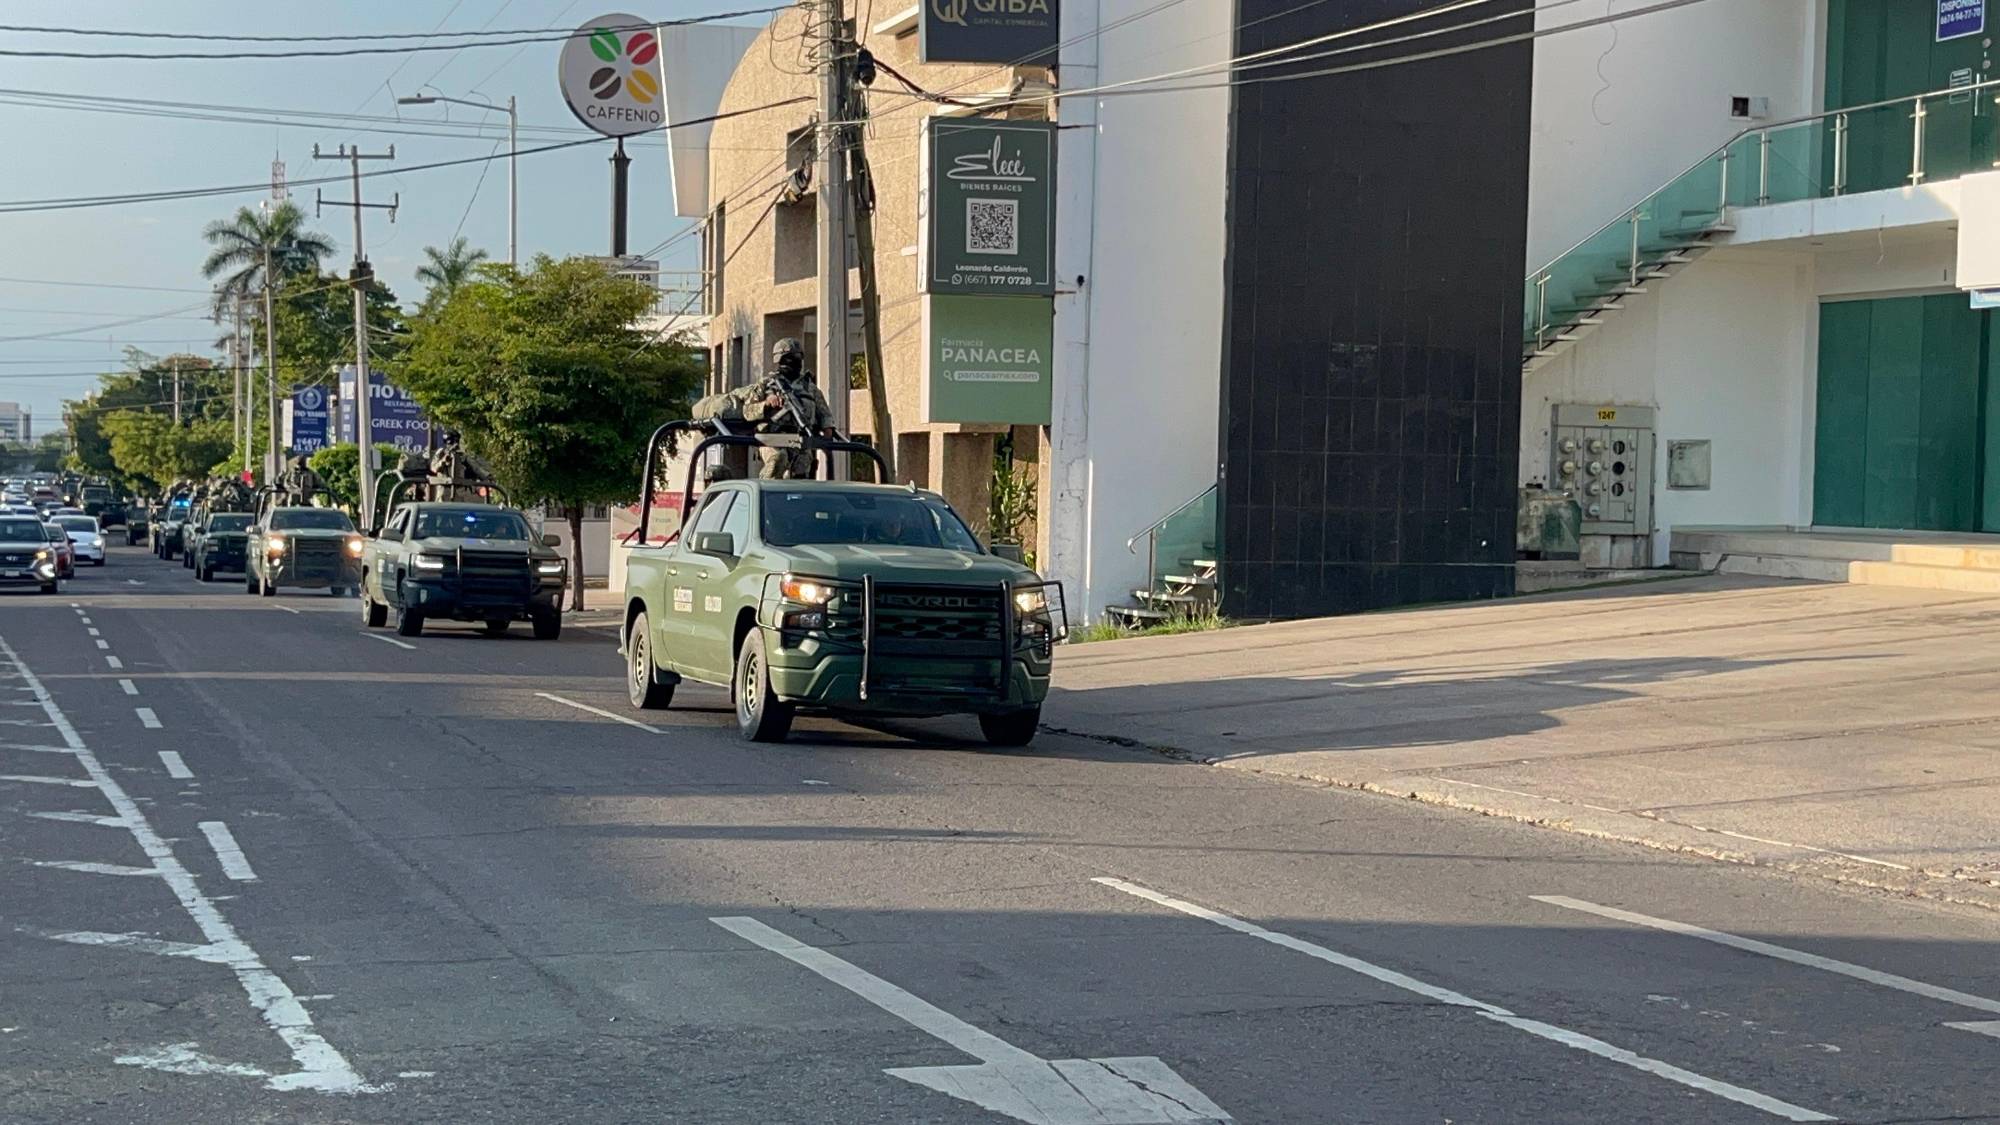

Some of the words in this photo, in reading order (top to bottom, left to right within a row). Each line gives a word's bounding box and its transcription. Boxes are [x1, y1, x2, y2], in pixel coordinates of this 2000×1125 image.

[586, 105, 660, 123] CAFFENIO
[960, 183, 991, 191] BIENES
[955, 264, 992, 272] Leonardo
[990, 275, 1006, 285] 177
[1007, 276, 1032, 286] 0728
[941, 338, 983, 347] Farmacia
[941, 348, 1040, 364] PANACEA
[1598, 410, 1616, 420] 1247
[372, 418, 403, 429] GREEK
[406, 420, 430, 431] FOO
